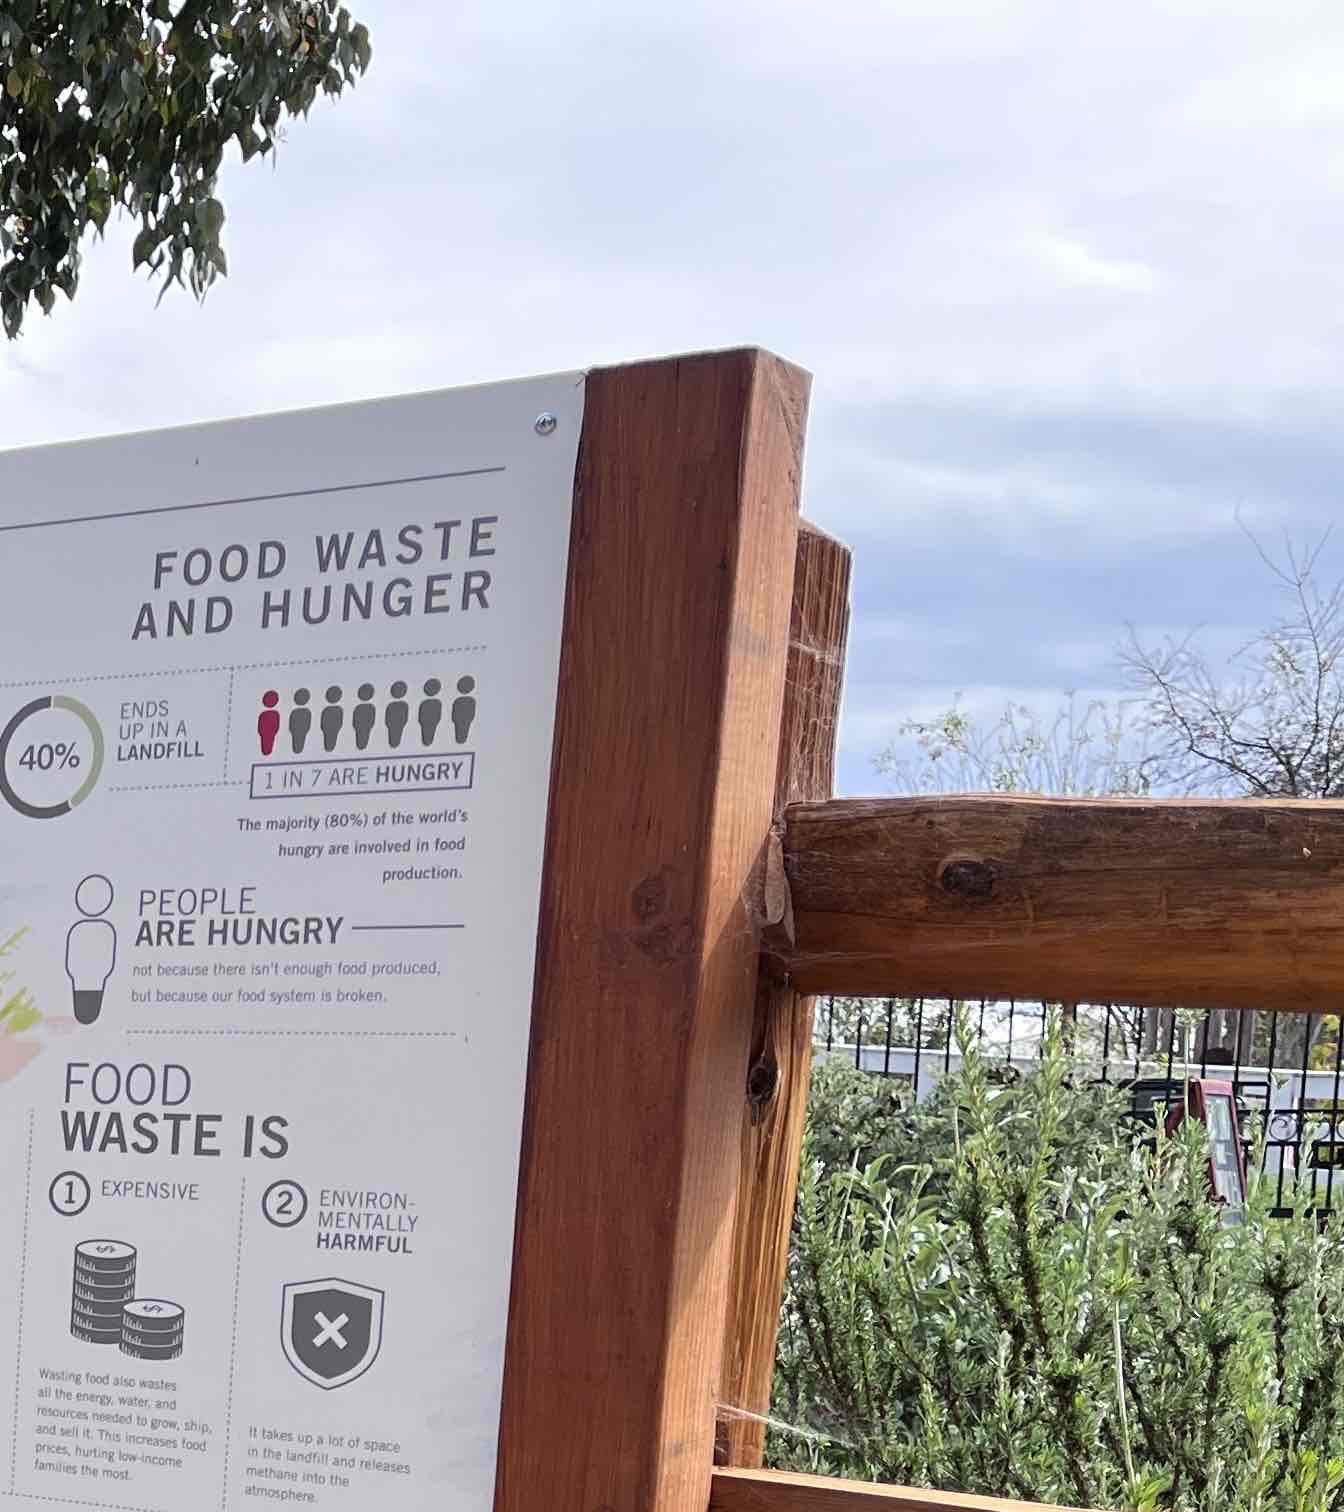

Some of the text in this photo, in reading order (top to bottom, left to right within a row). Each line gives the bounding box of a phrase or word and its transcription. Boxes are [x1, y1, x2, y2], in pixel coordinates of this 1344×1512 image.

[152, 514, 500, 591] FOOD WASTE
[130, 569, 493, 641] AND HUNGER
[119, 699, 170, 721] ENDS
[118, 718, 188, 742] UP IN A
[17, 741, 82, 772] 40%
[116, 739, 205, 763] LANDFILL
[264, 759, 465, 791] 1 IN 7 ARE HUNGRY
[235, 807, 470, 834] The majority (80%) of the world's
[277, 834, 467, 860] hungry are involved in food
[381, 864, 464, 886] production.
[137, 886, 257, 918] PEOPLE
[133, 916, 345, 948] ARE HUNGRY
[131, 958, 442, 979] not because there isn't enough food produced,
[63, 1061, 193, 1108] FOOD
[59, 1108, 290, 1160] WASTE IS
[100, 1178, 201, 1202] EXPENSIVE
[318, 1188, 416, 1212] ENVIRON-
[317, 1209, 420, 1234] MENTALLY
[315, 1230, 414, 1255] HARMFUL
[244, 1465, 351, 1489] methane into the
[243, 1483, 317, 1504] atmosphere.
